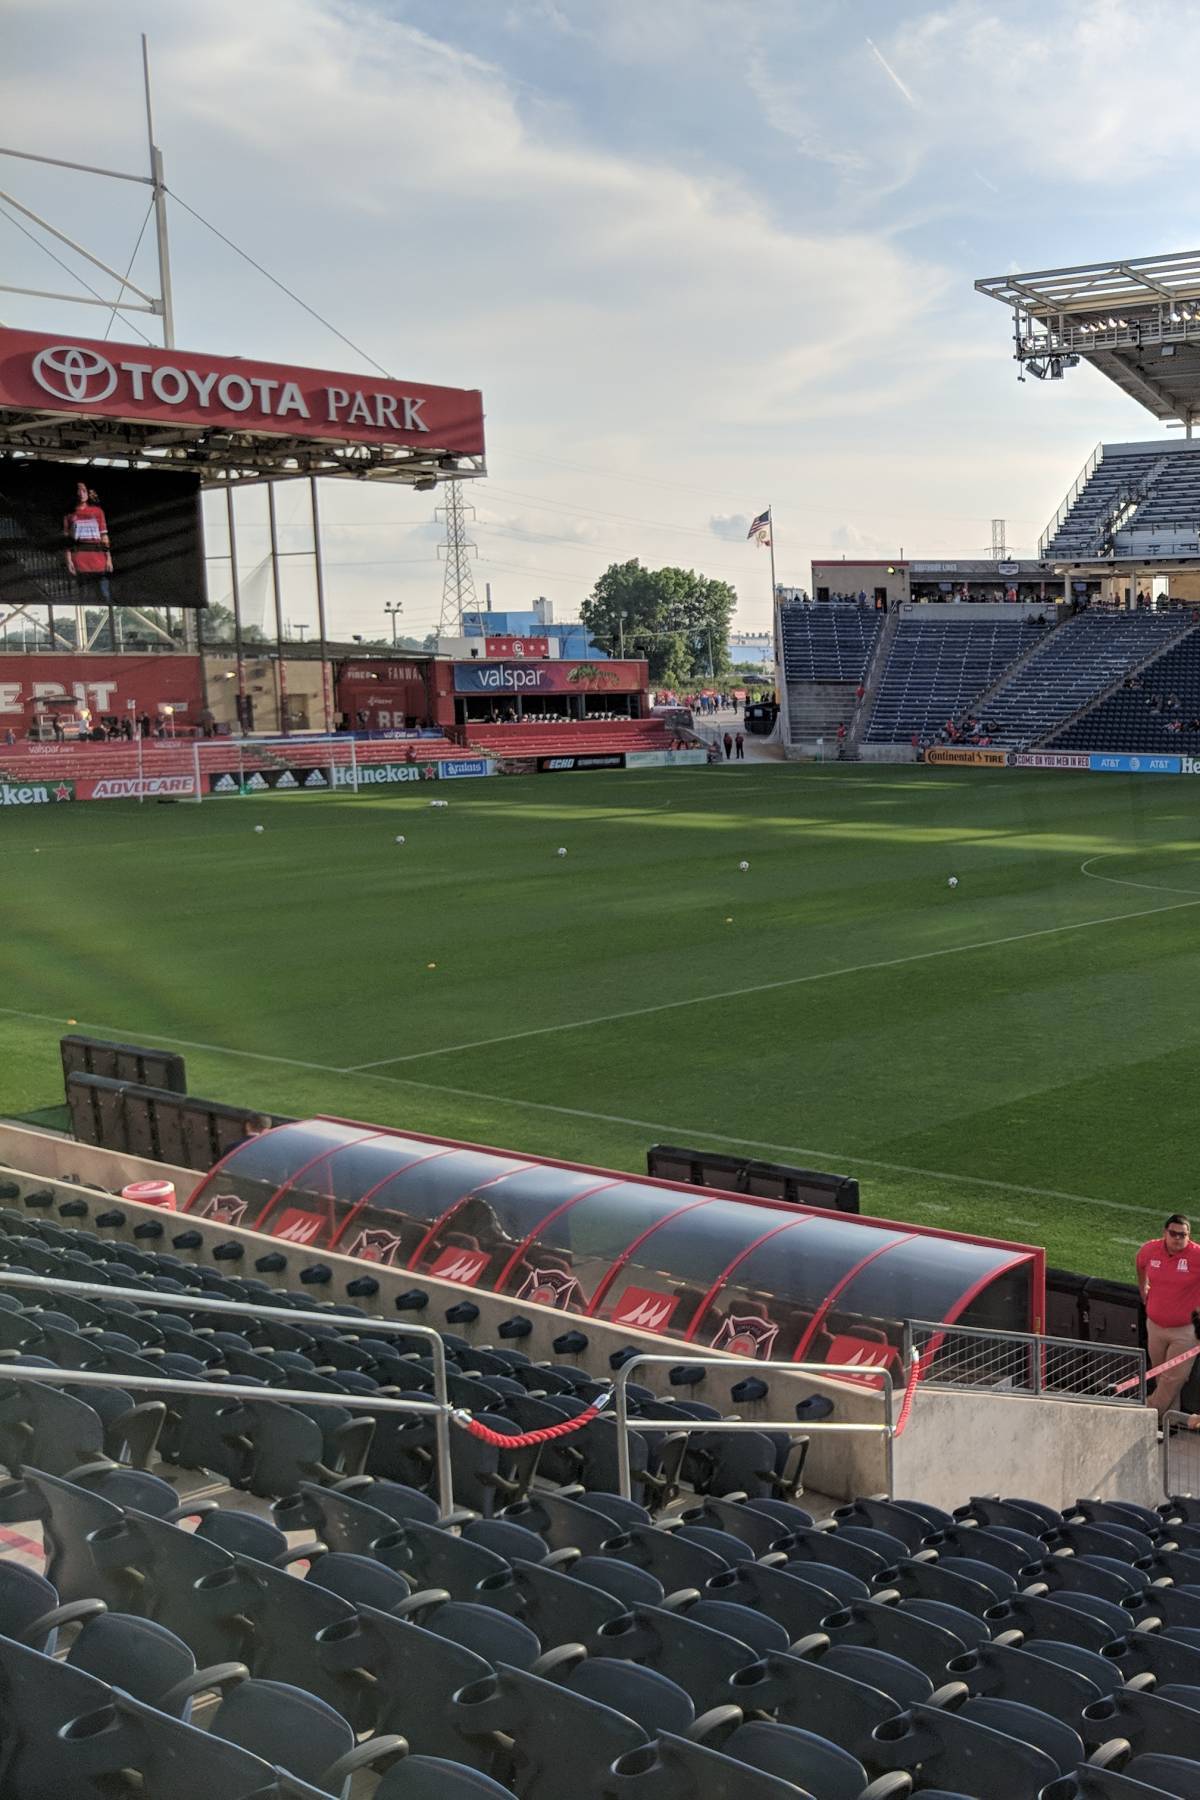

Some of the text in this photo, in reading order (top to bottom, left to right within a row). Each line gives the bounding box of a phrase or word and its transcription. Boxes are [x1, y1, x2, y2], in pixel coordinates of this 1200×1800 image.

[120, 361, 431, 432] TOYOTA PARK
[478, 664, 545, 691] valspar
[549, 759, 575, 769] ECHO
[928, 750, 1004, 764] Continental TIRE
[1101, 758, 1120, 767] AT&T
[1149, 760, 1169, 769] AT&T
[94, 777, 195, 798] ADVOCARE
